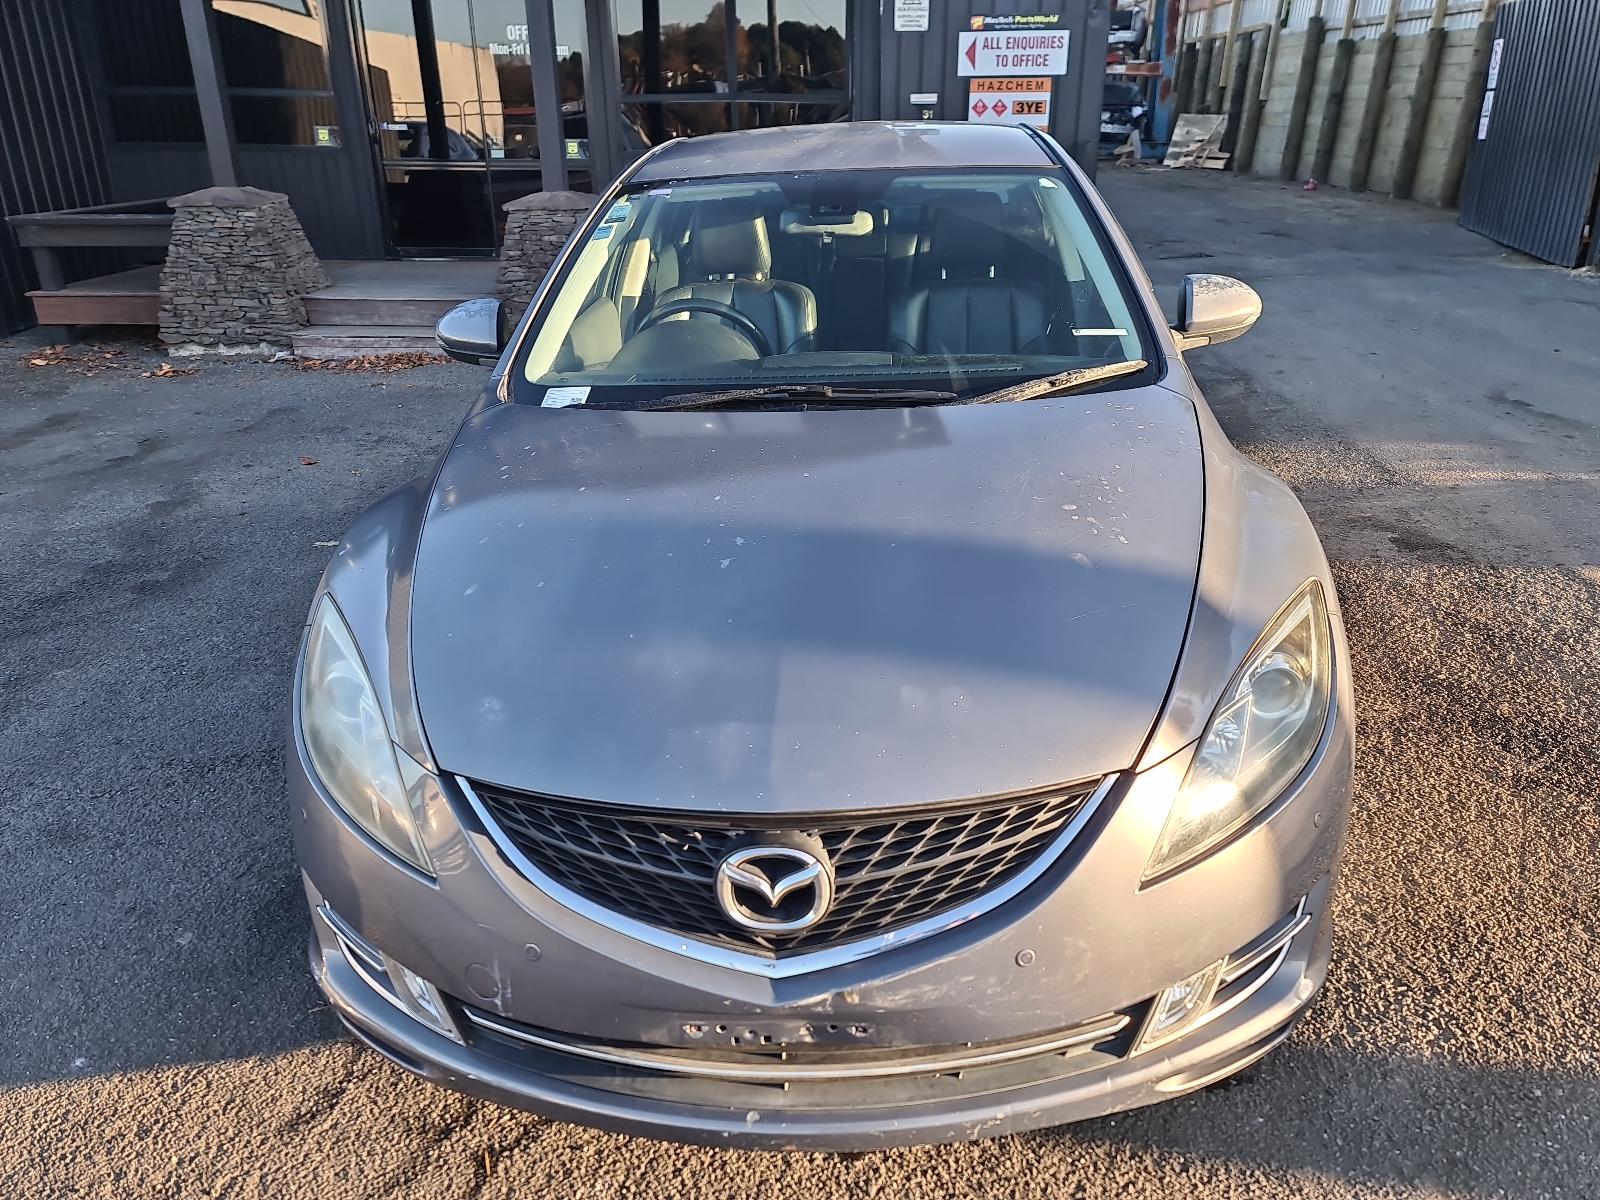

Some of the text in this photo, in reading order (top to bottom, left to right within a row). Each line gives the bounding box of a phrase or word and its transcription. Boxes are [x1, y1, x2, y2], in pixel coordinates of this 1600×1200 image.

[506, 24, 529, 41] OFF
[488, 42, 525, 56] Mon-Fri
[982, 35, 1065, 51] ALL ENQUIRIES
[995, 53, 1050, 68] TO OFFICE
[977, 80, 1045, 91] HAZCHEM
[1015, 101, 1044, 113] 3YE
[922, 109, 934, 120] 31
